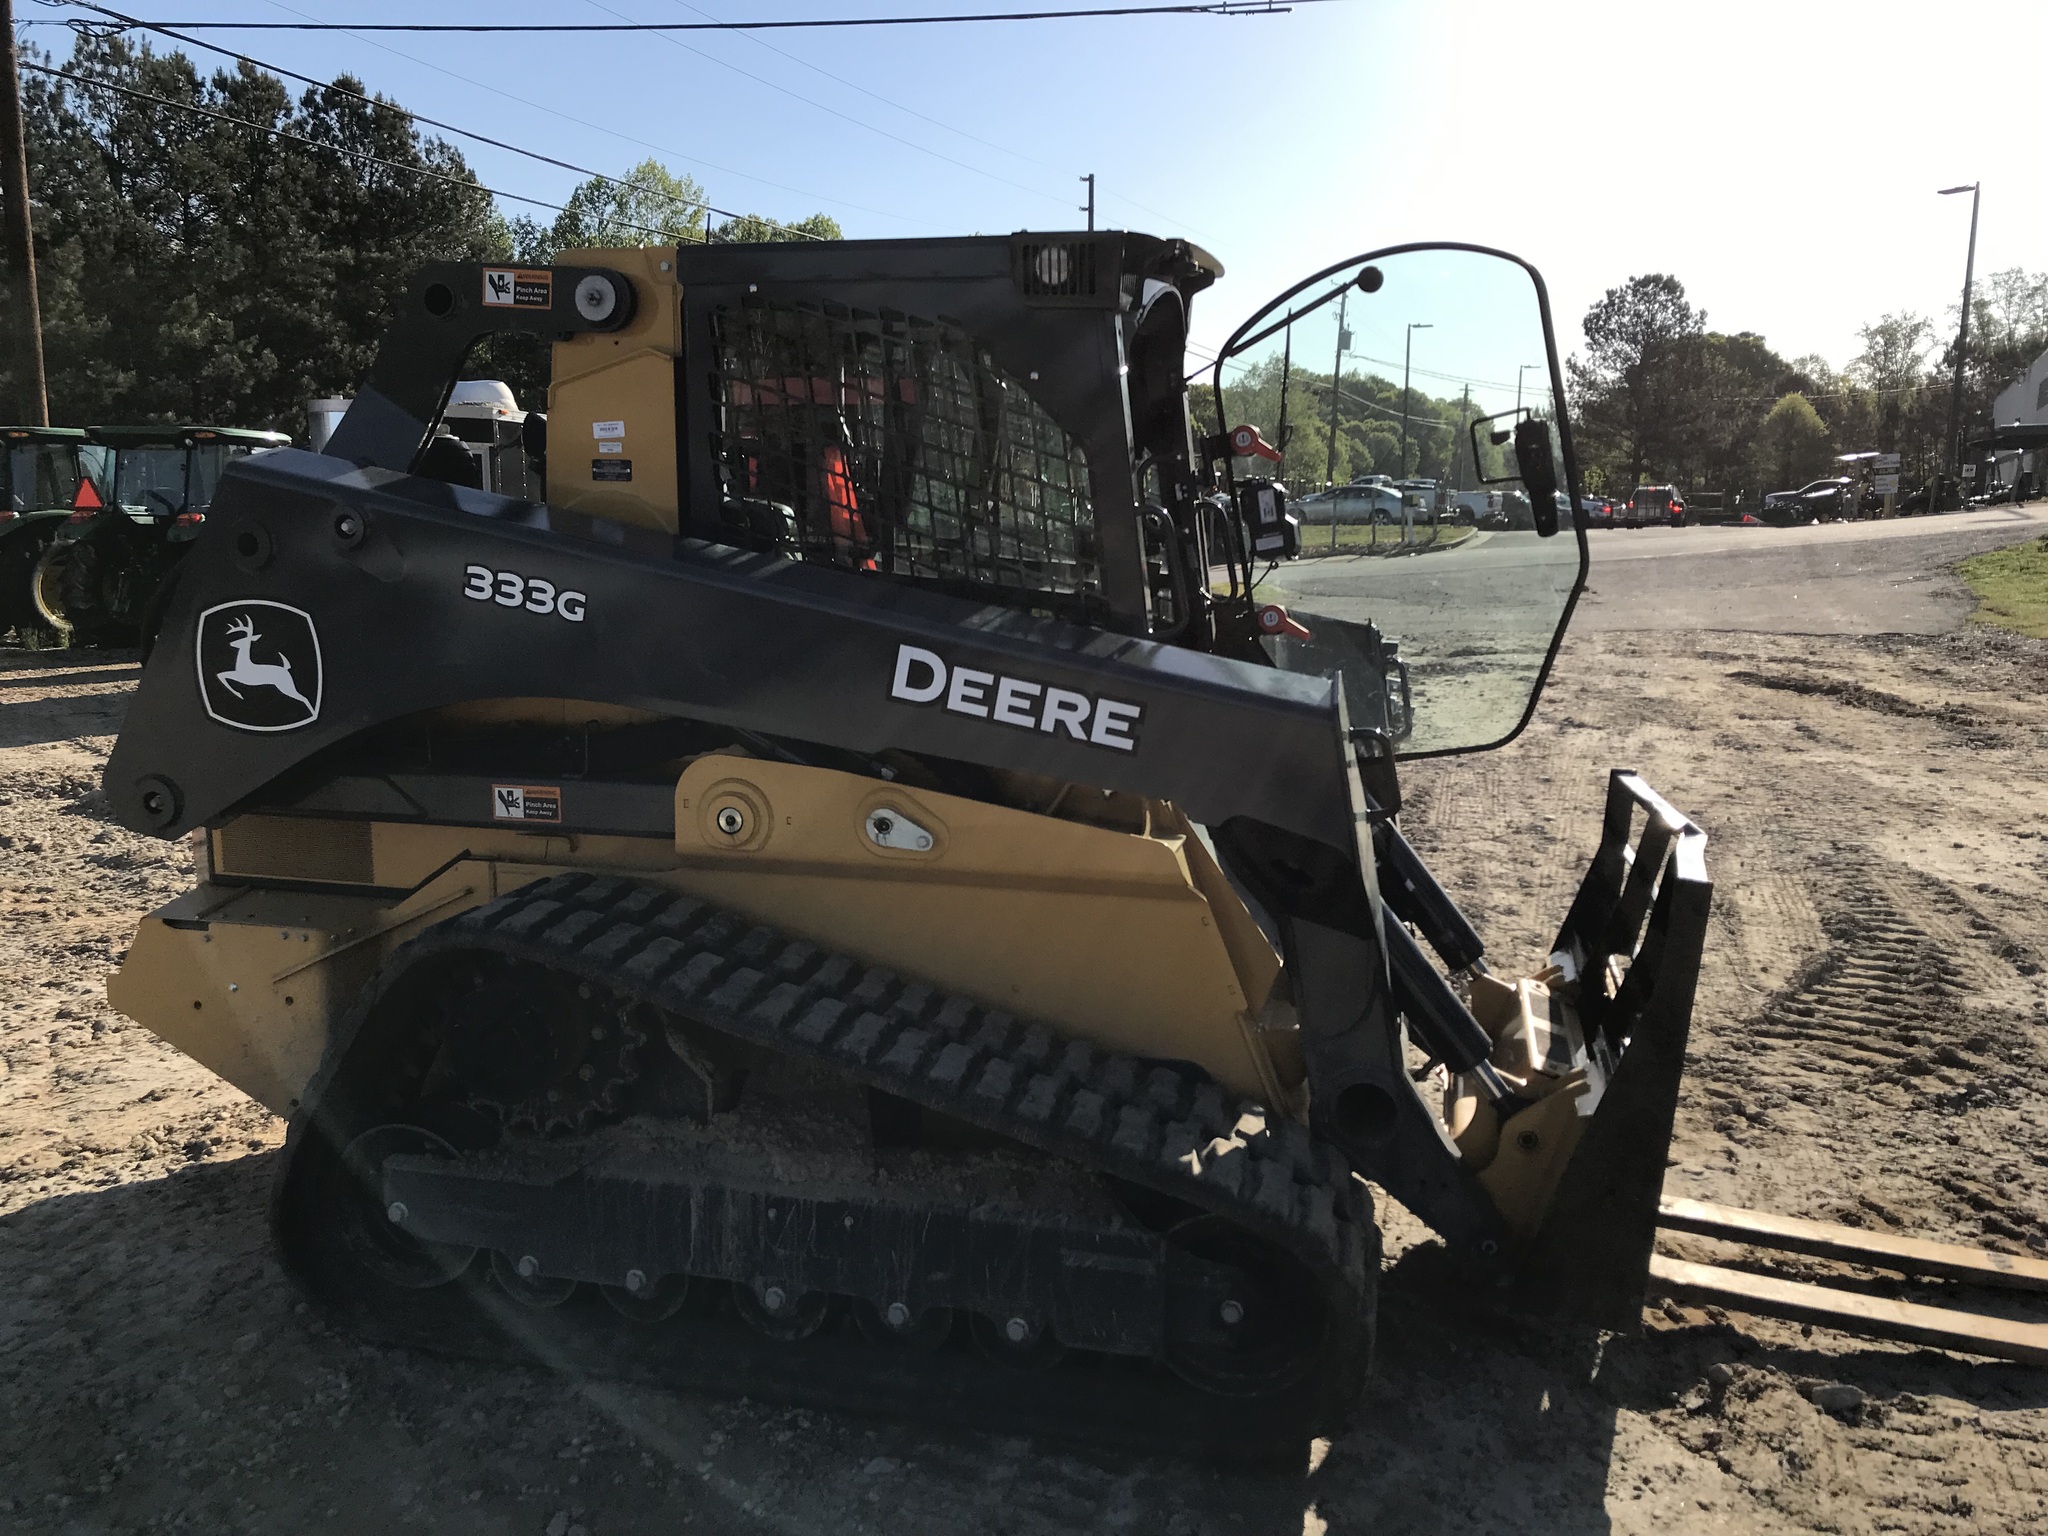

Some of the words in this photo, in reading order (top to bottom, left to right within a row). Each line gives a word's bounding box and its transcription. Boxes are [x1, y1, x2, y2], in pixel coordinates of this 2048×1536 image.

[534, 287, 548, 295] Area
[515, 294, 529, 302] Keep
[464, 565, 586, 622] 333G
[891, 643, 1141, 751] DEERE
[538, 809, 553, 817] Away
